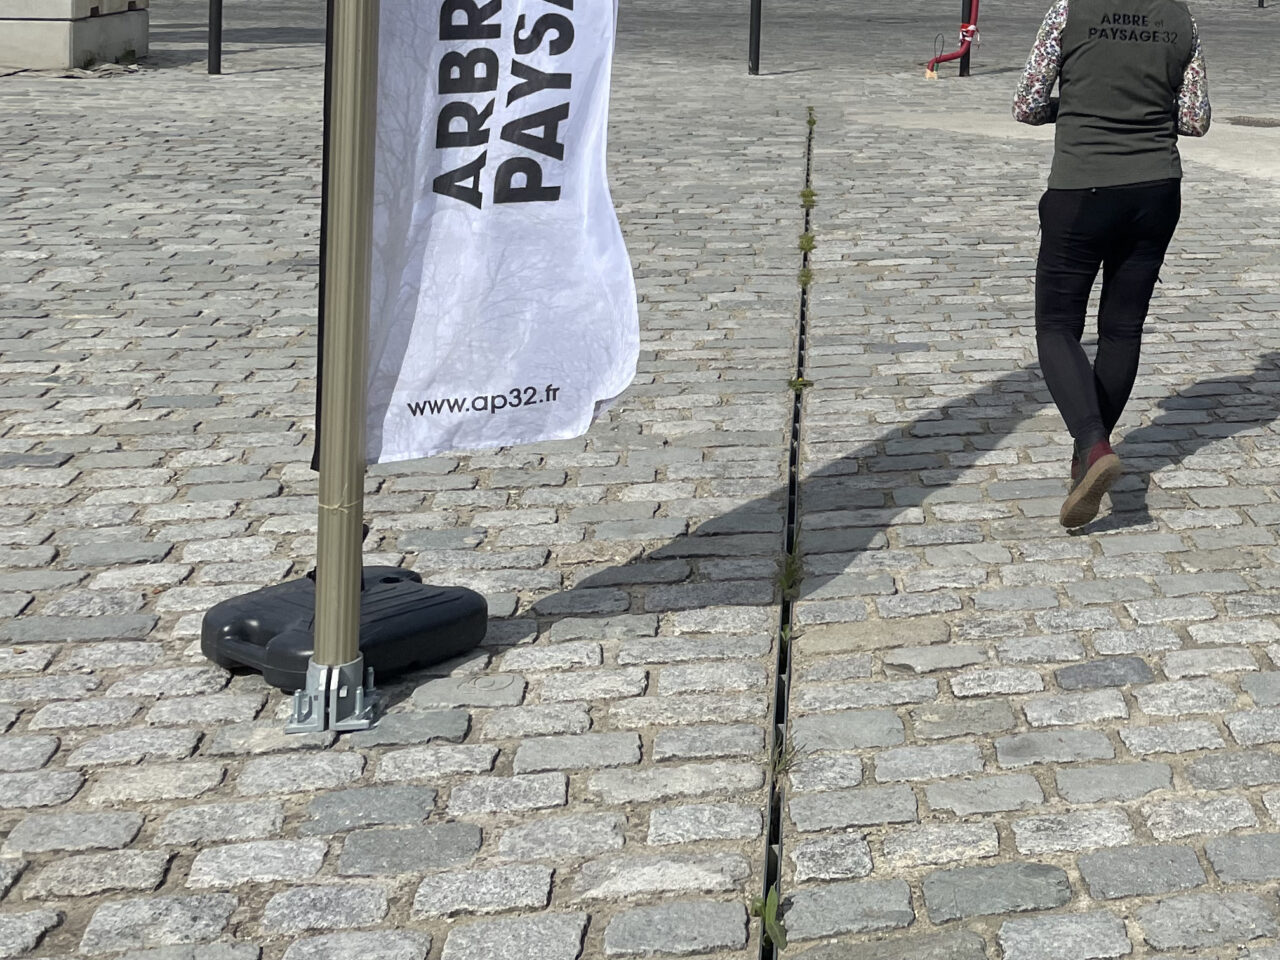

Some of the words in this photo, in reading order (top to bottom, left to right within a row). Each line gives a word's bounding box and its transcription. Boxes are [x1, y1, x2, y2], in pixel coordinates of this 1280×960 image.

[1101, 13, 1149, 27] ARBRE
[1088, 27, 1160, 43] PAYSAGE
[407, 384, 560, 417] www.ap32.fr
